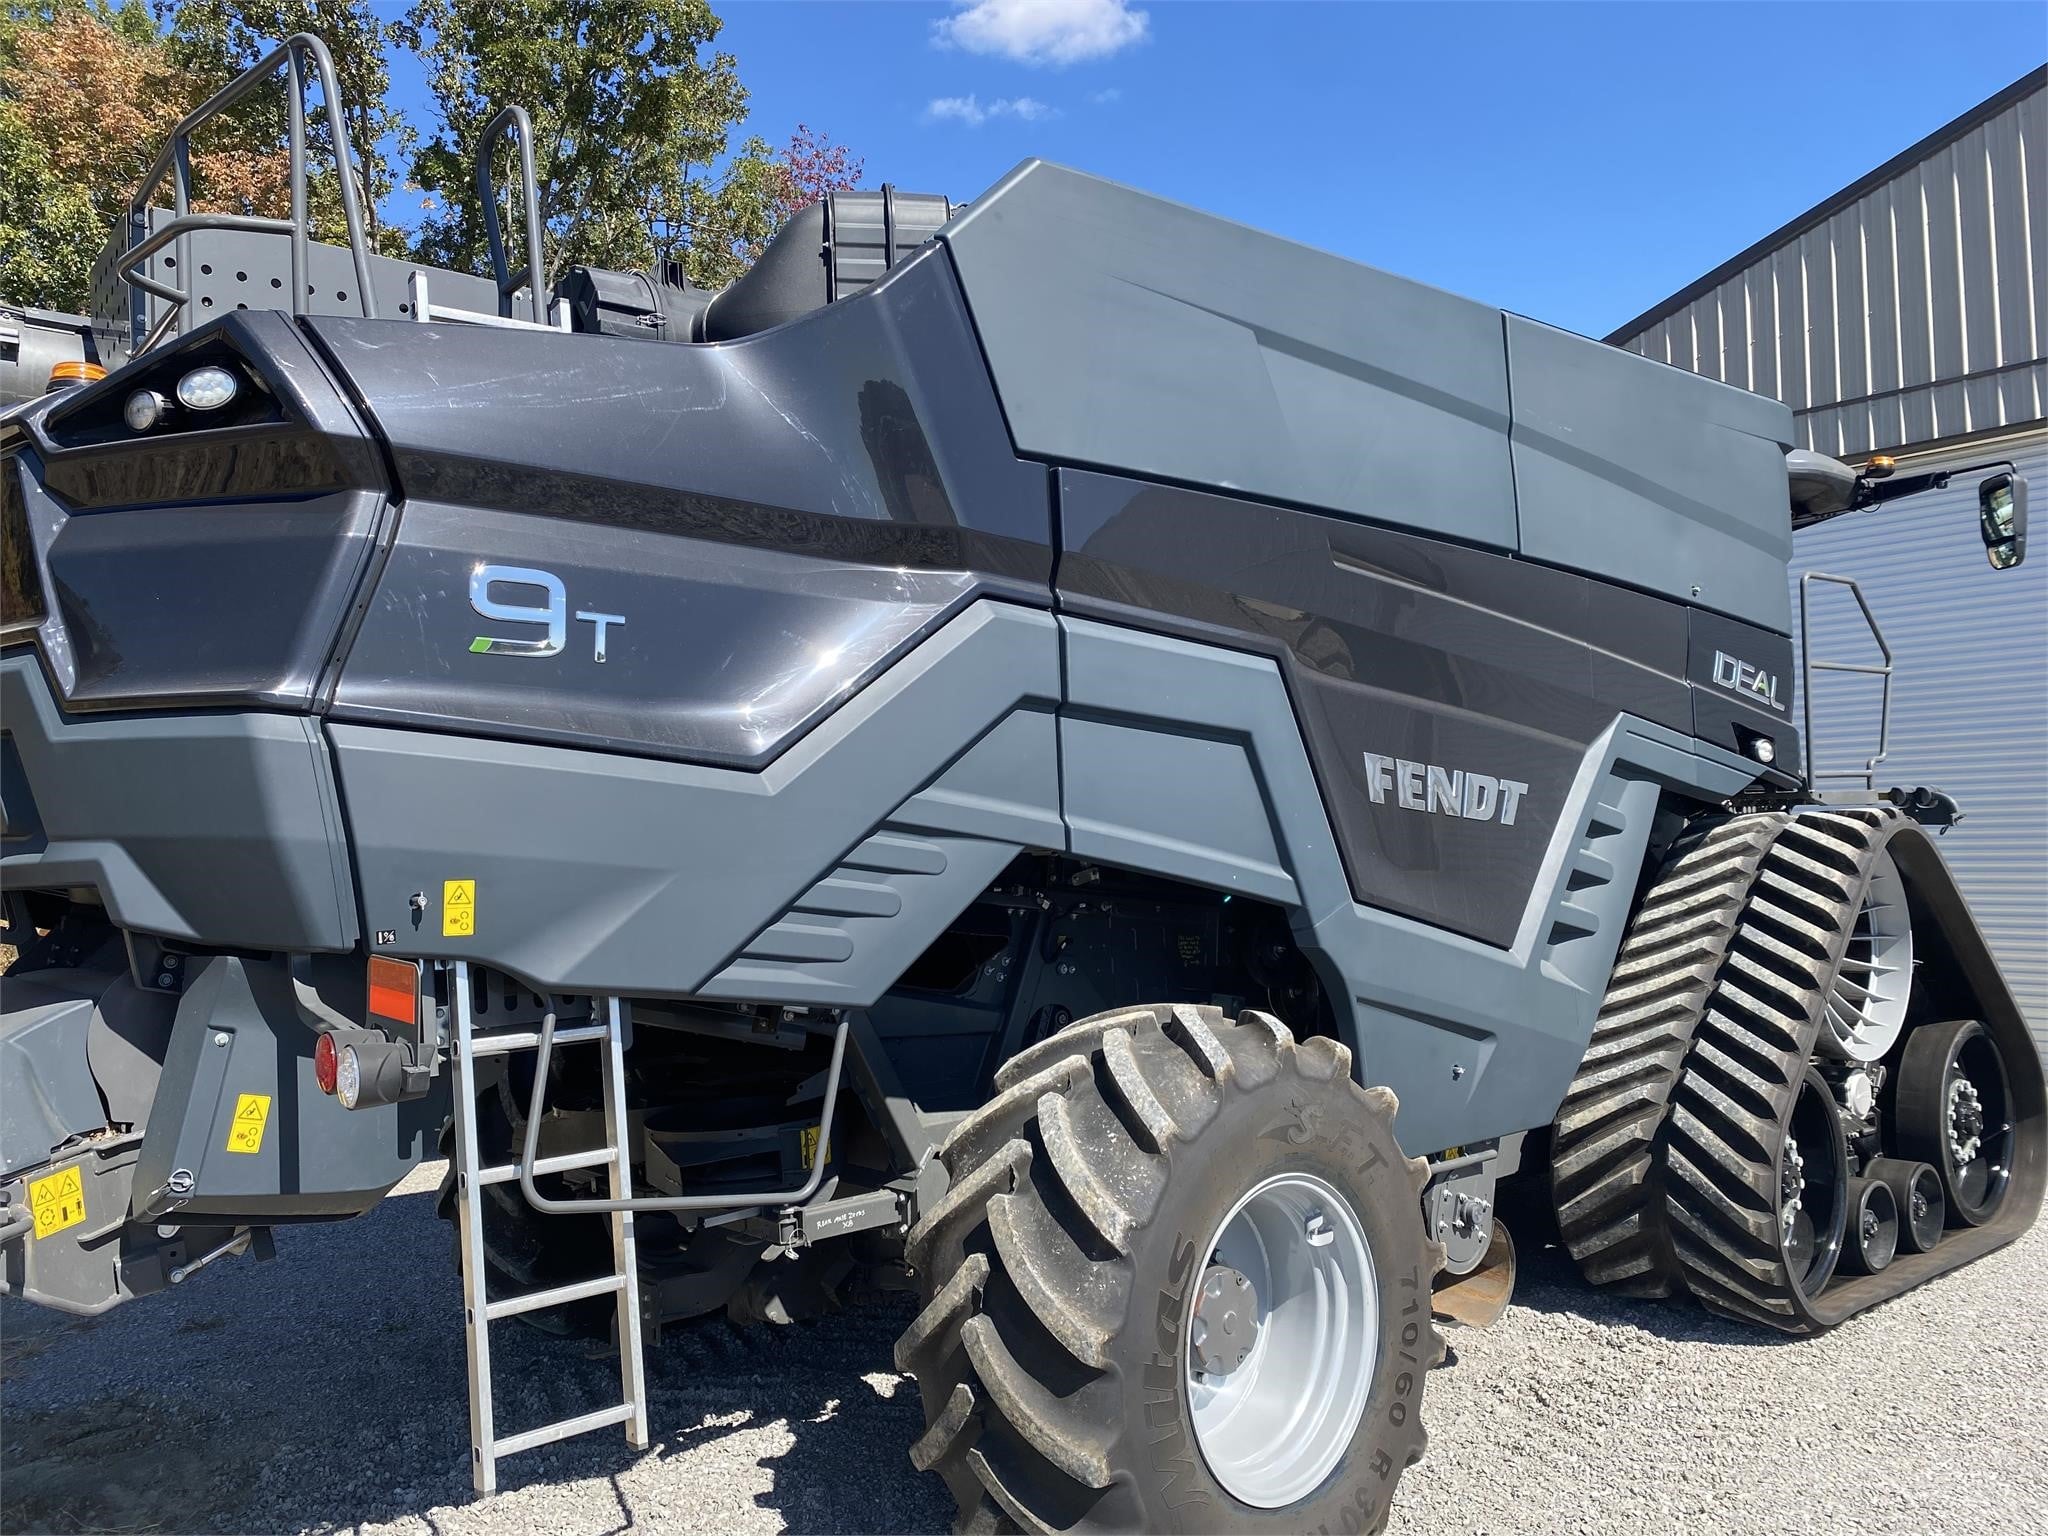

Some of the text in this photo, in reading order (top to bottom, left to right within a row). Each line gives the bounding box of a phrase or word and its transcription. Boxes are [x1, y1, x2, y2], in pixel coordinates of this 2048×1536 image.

[1712, 649, 1786, 712] IDEAL
[1363, 751, 1529, 826] FENDT
[1388, 1265, 1420, 1428] 710/60
[1368, 1447, 1393, 1481] R
